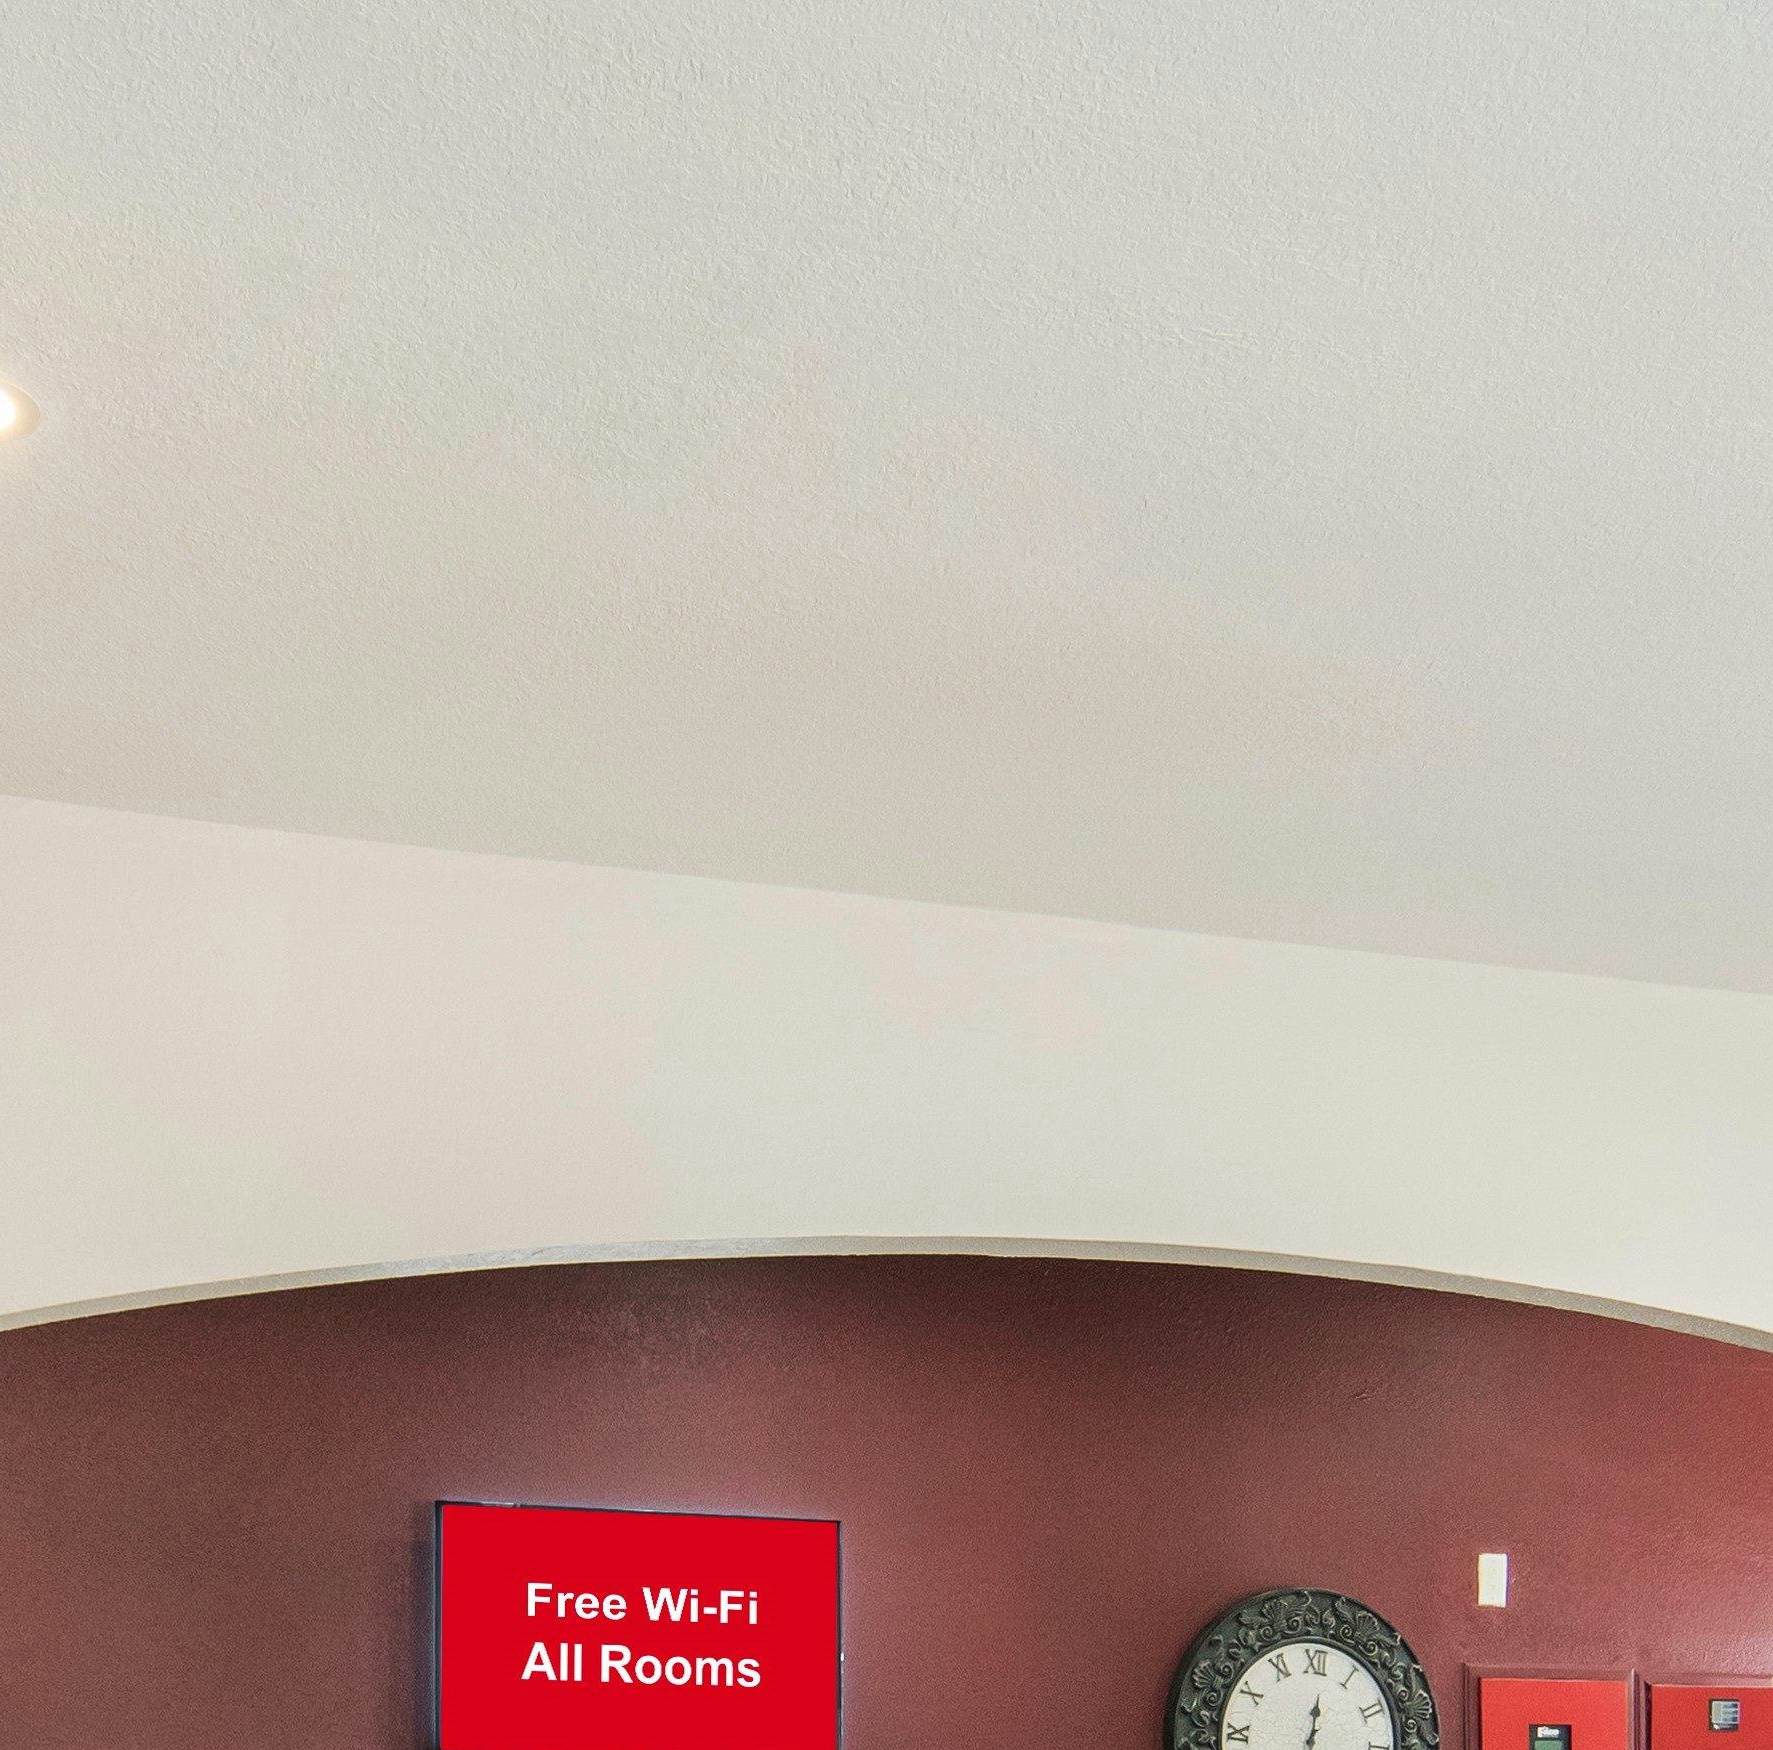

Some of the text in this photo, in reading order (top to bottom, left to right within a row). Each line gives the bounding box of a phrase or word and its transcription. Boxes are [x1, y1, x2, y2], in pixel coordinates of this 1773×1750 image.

[526, 1582, 759, 1625] Free Wi-Fi
[521, 1642, 761, 1688] All Rooms
[1268, 1652, 1292, 1682] XI
[1304, 1649, 1329, 1676] XII
[1340, 1665, 1359, 1689] I
[1240, 1680, 1264, 1706] X
[1360, 1698, 1384, 1724] II
[1227, 1723, 1250, 1744] IX
